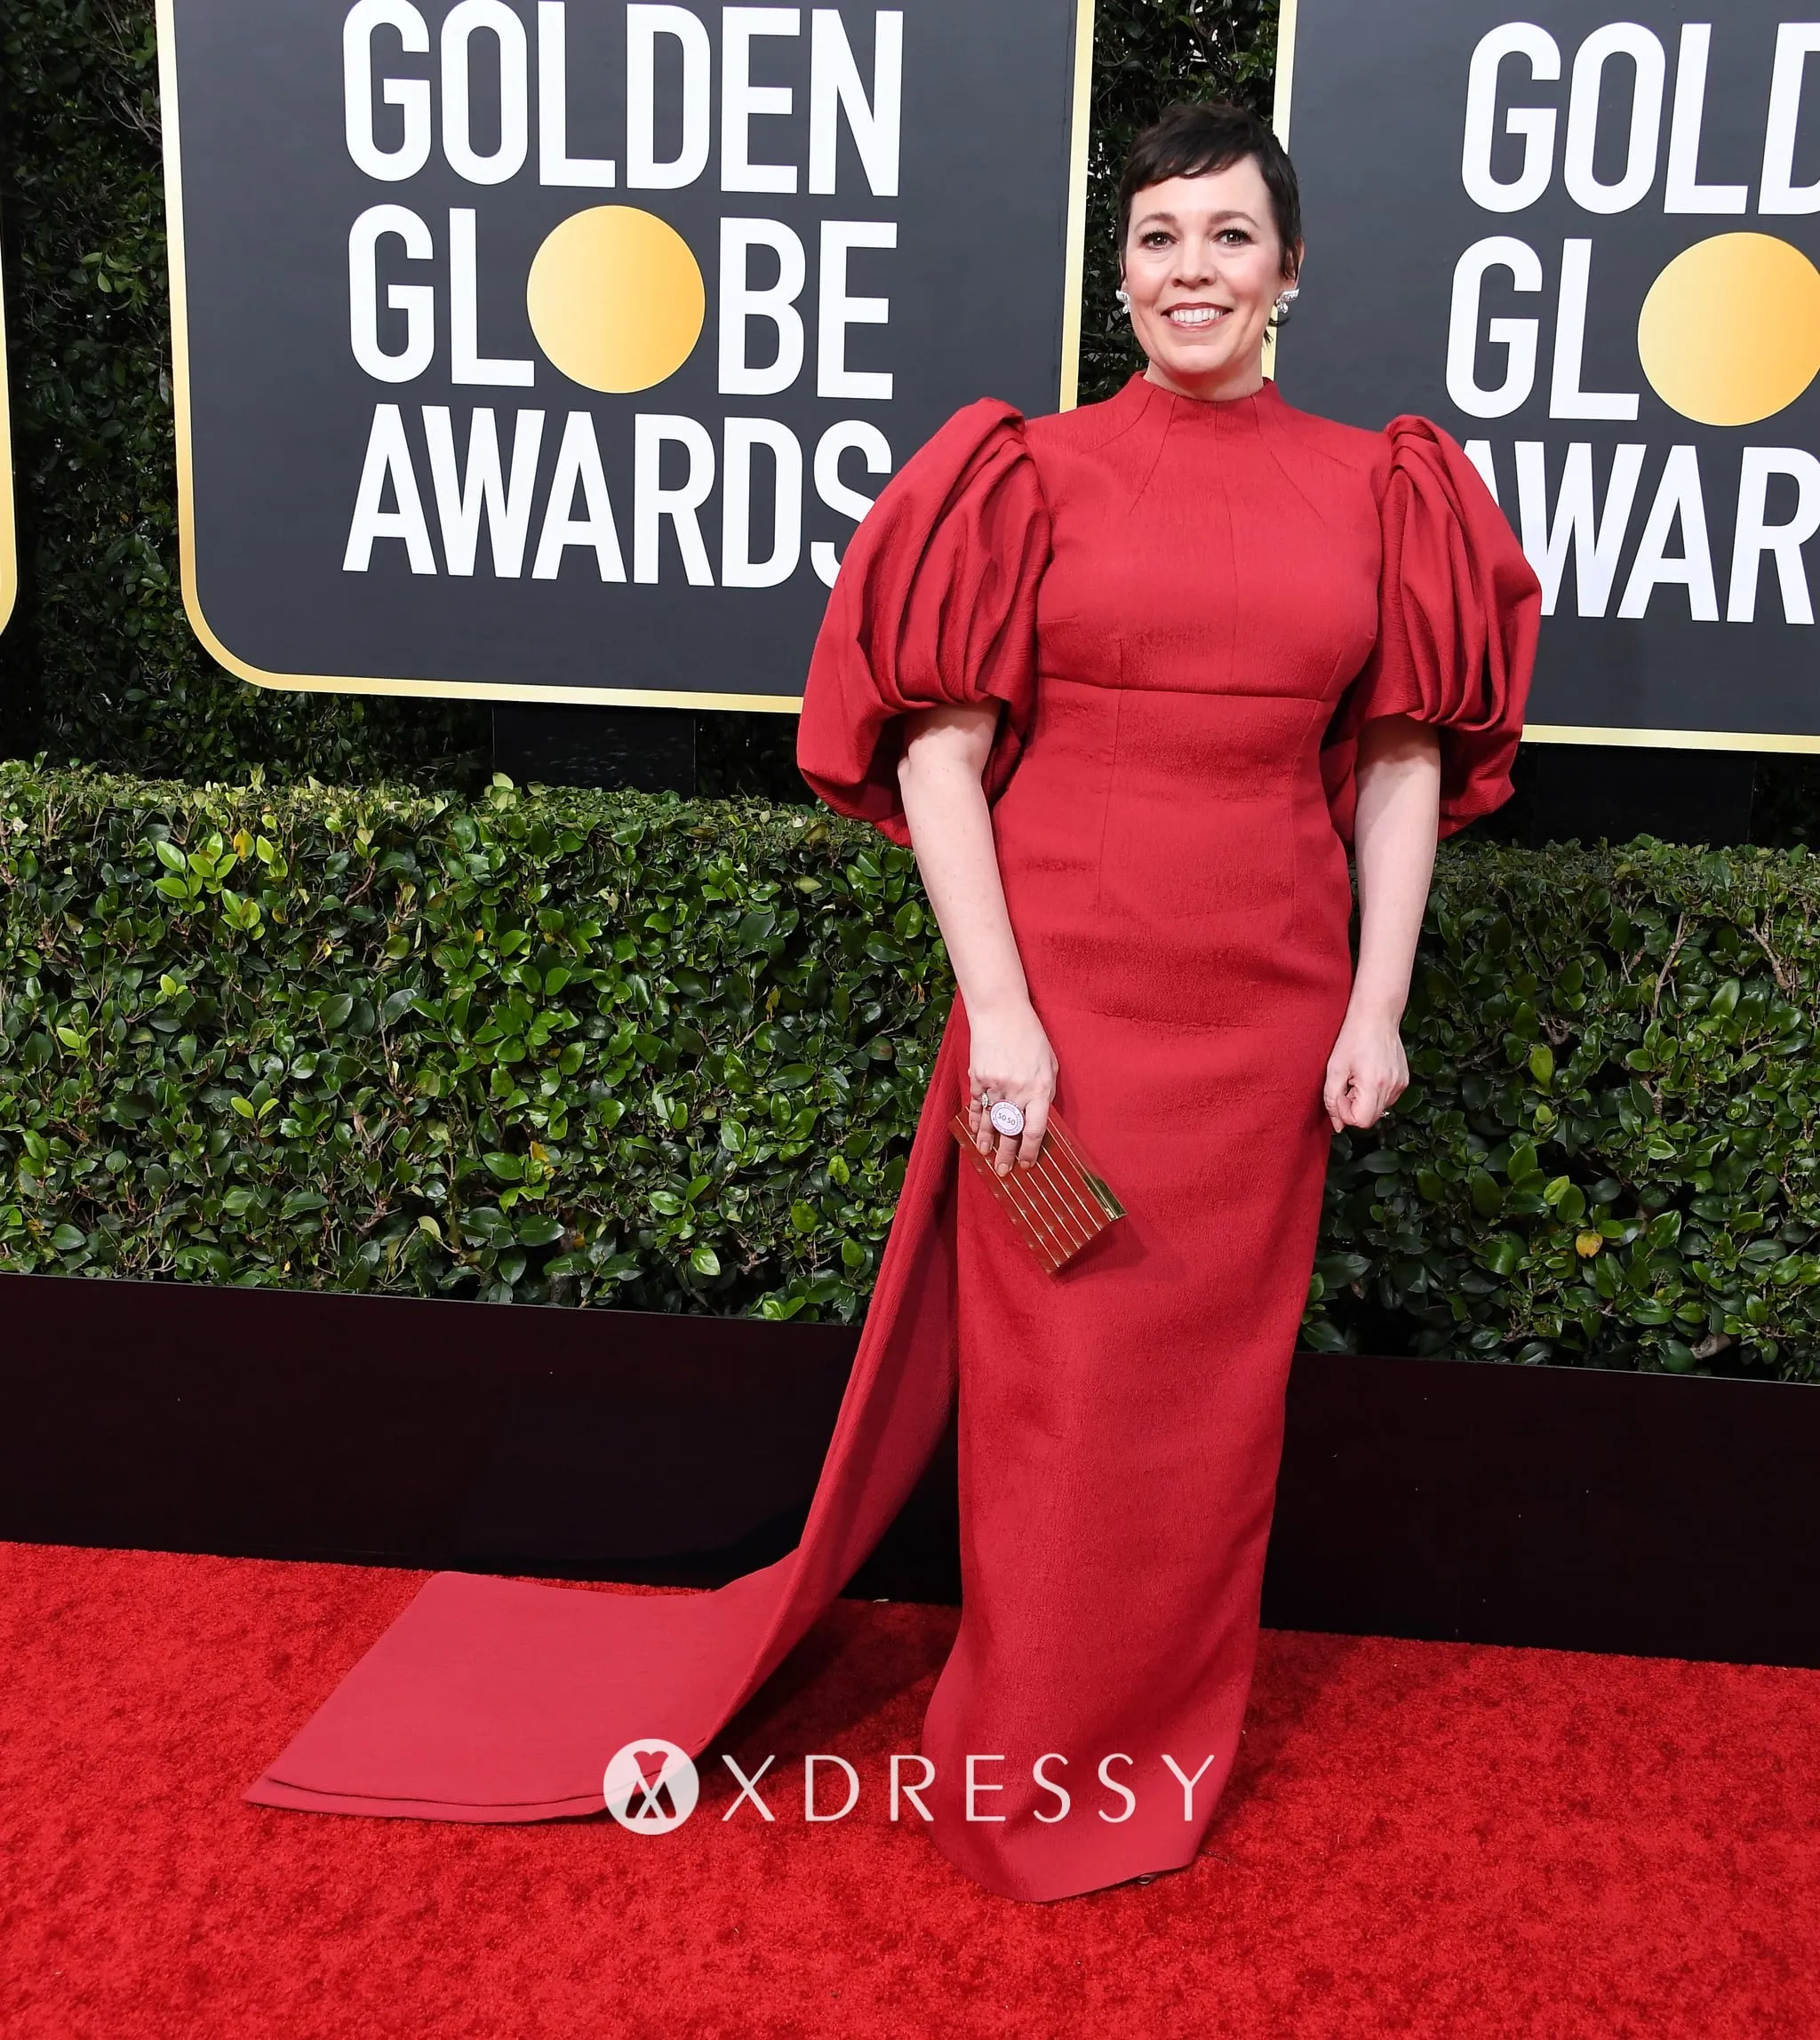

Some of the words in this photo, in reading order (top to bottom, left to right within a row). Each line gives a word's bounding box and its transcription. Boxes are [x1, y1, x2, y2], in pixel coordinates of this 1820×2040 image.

[343, 0, 904, 197] GOLDEN
[348, 203, 898, 400] GLOBE
[342, 403, 892, 589] AWARDS
